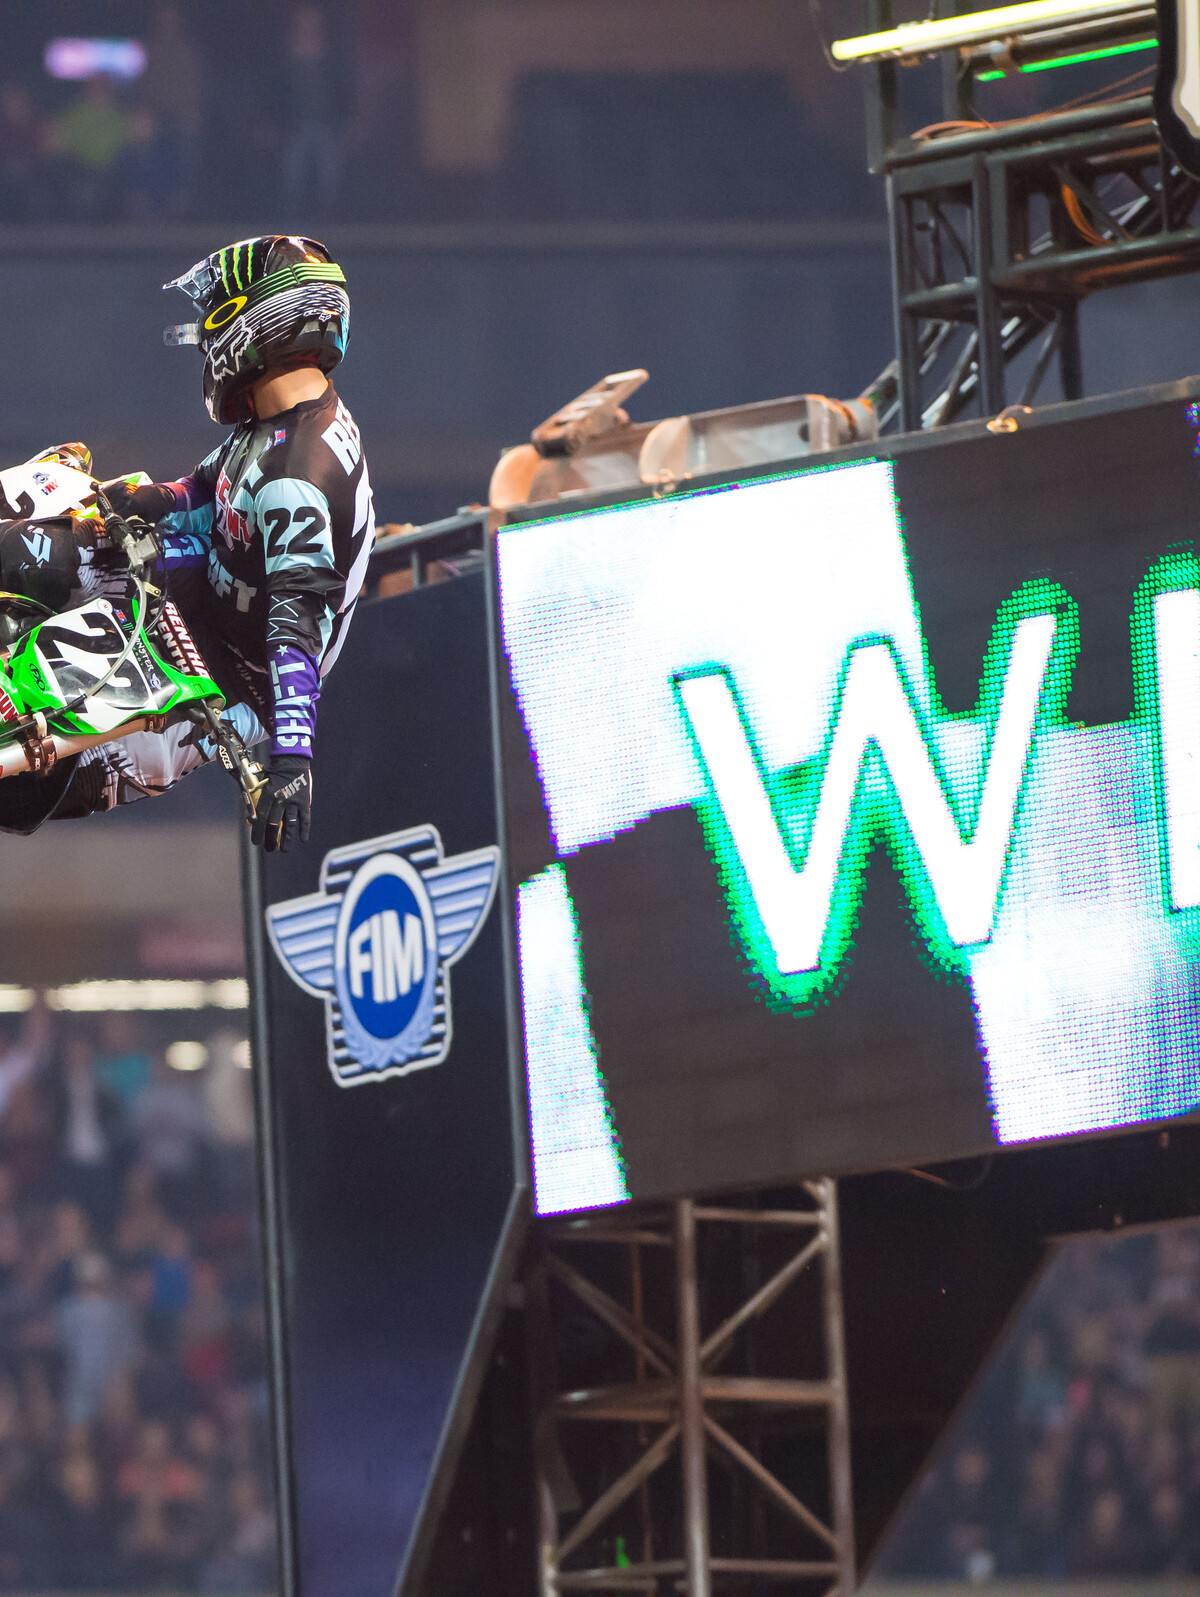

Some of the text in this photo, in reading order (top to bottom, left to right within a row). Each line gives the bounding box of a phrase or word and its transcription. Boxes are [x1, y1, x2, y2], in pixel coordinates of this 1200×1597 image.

[264, 507, 327, 554] 22
[34, 611, 151, 714] 22
[163, 600, 212, 679] RENTHA
[270, 659, 312, 748] SHIFT
[274, 773, 308, 804] SHIFT
[349, 909, 425, 1004] FIM
